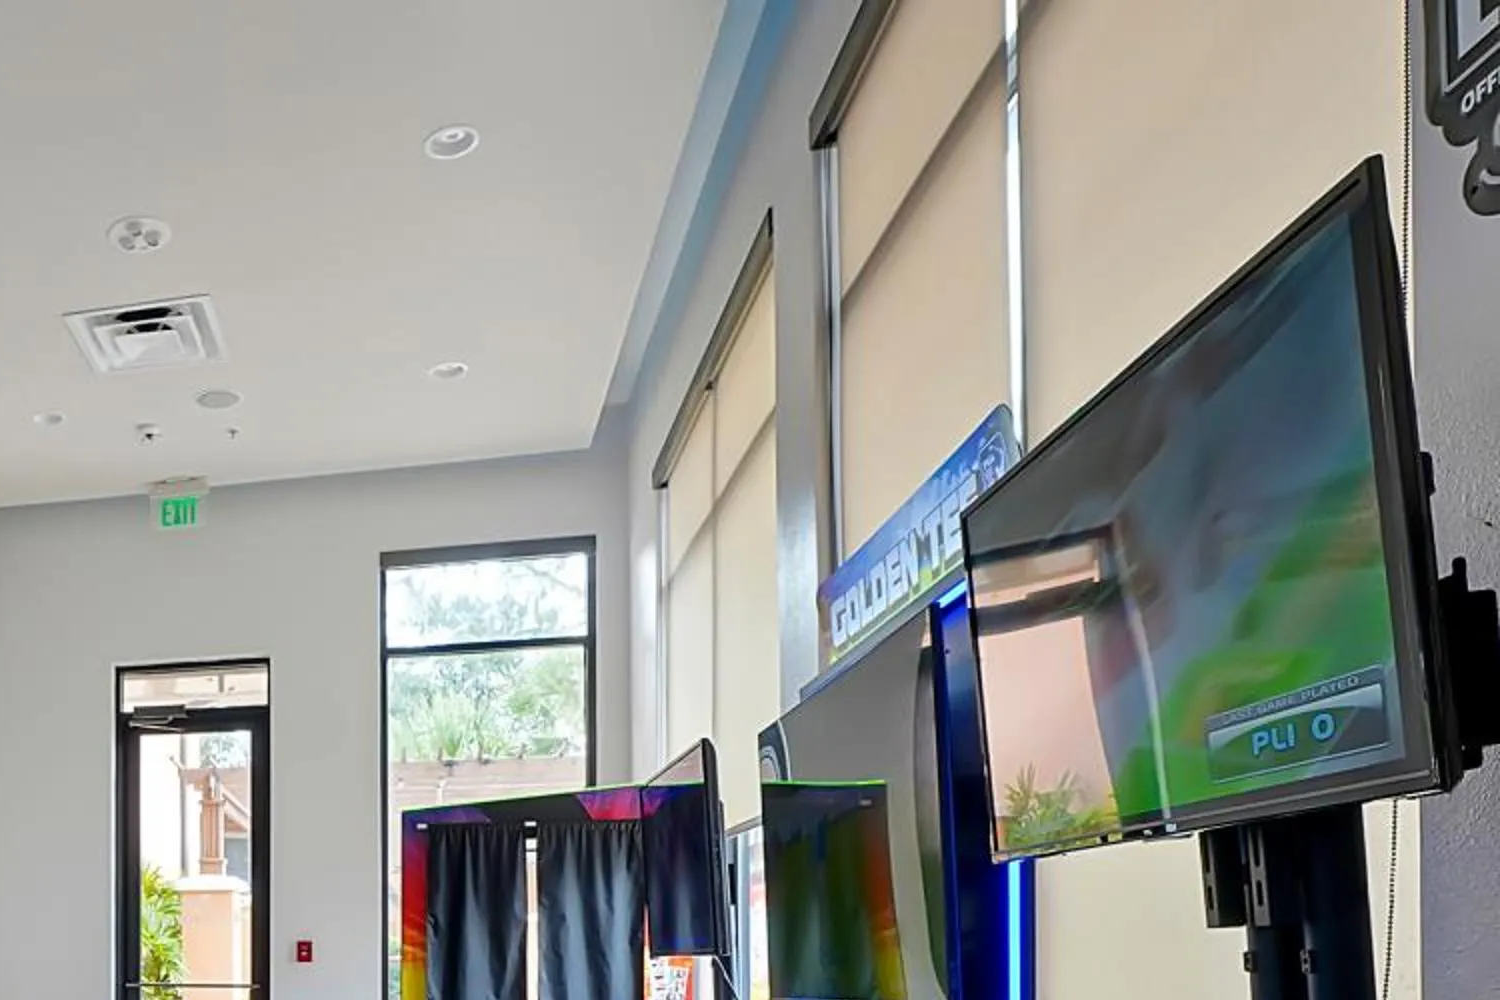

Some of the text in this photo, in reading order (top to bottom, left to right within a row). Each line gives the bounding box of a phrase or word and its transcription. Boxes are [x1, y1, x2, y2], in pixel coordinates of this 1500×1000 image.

[163, 498, 197, 527] EXIT
[830, 527, 920, 648] GOLDEN
[1300, 675, 1360, 701] PLAYED
